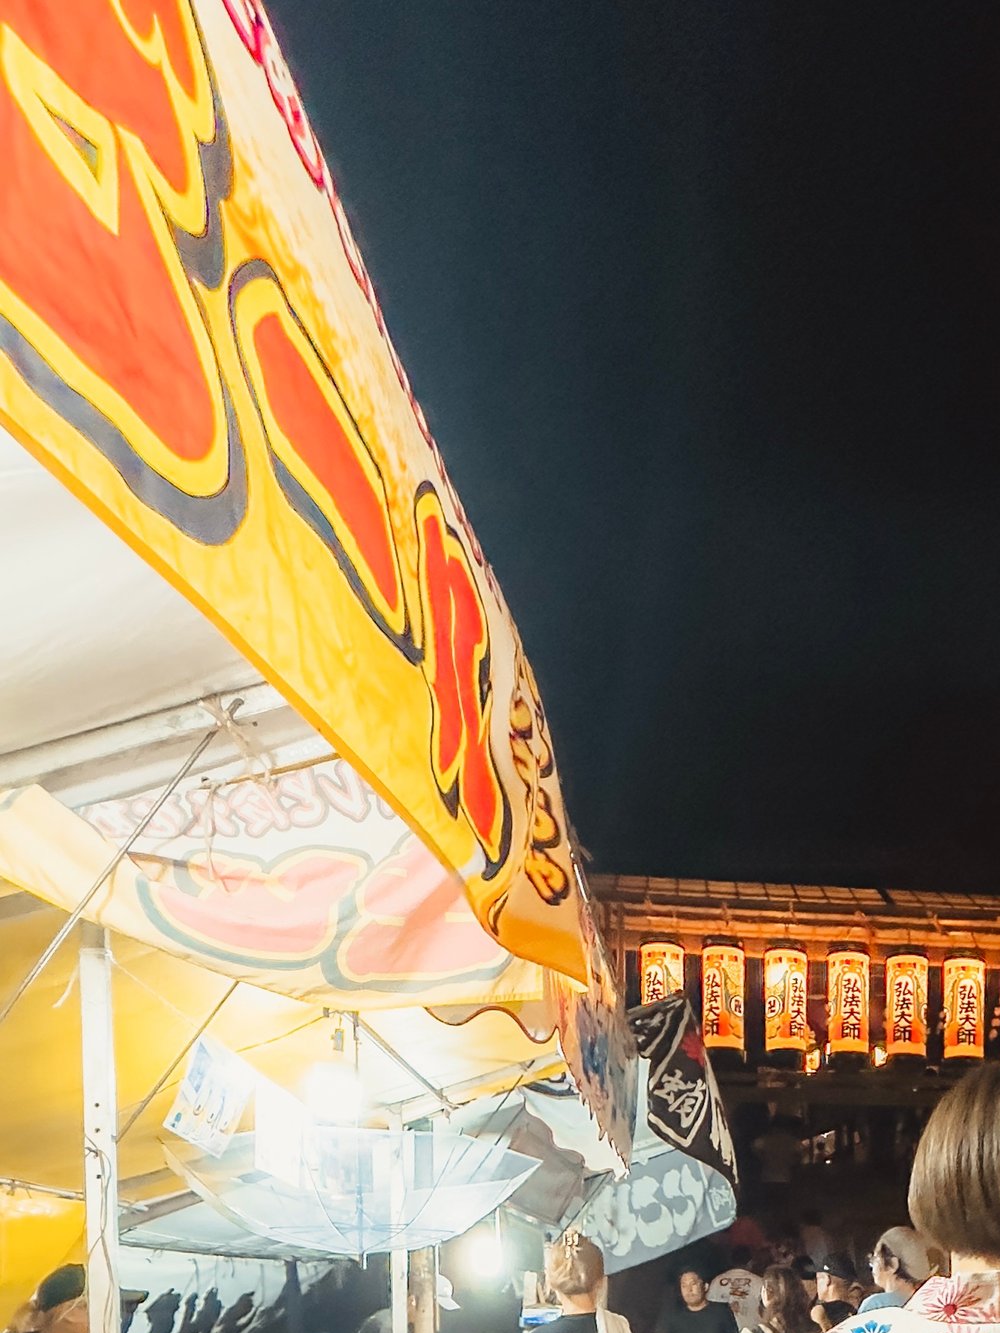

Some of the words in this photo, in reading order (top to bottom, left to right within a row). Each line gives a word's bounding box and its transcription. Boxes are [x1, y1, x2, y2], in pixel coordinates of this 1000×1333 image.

[704, 973, 722, 1036] 弘法大師
[790, 978, 806, 1038] 弘法大師
[842, 978, 861, 1040] 弘法大師
[893, 982, 914, 1043] 弘法大師
[956, 985, 978, 1046] 弘法大師
